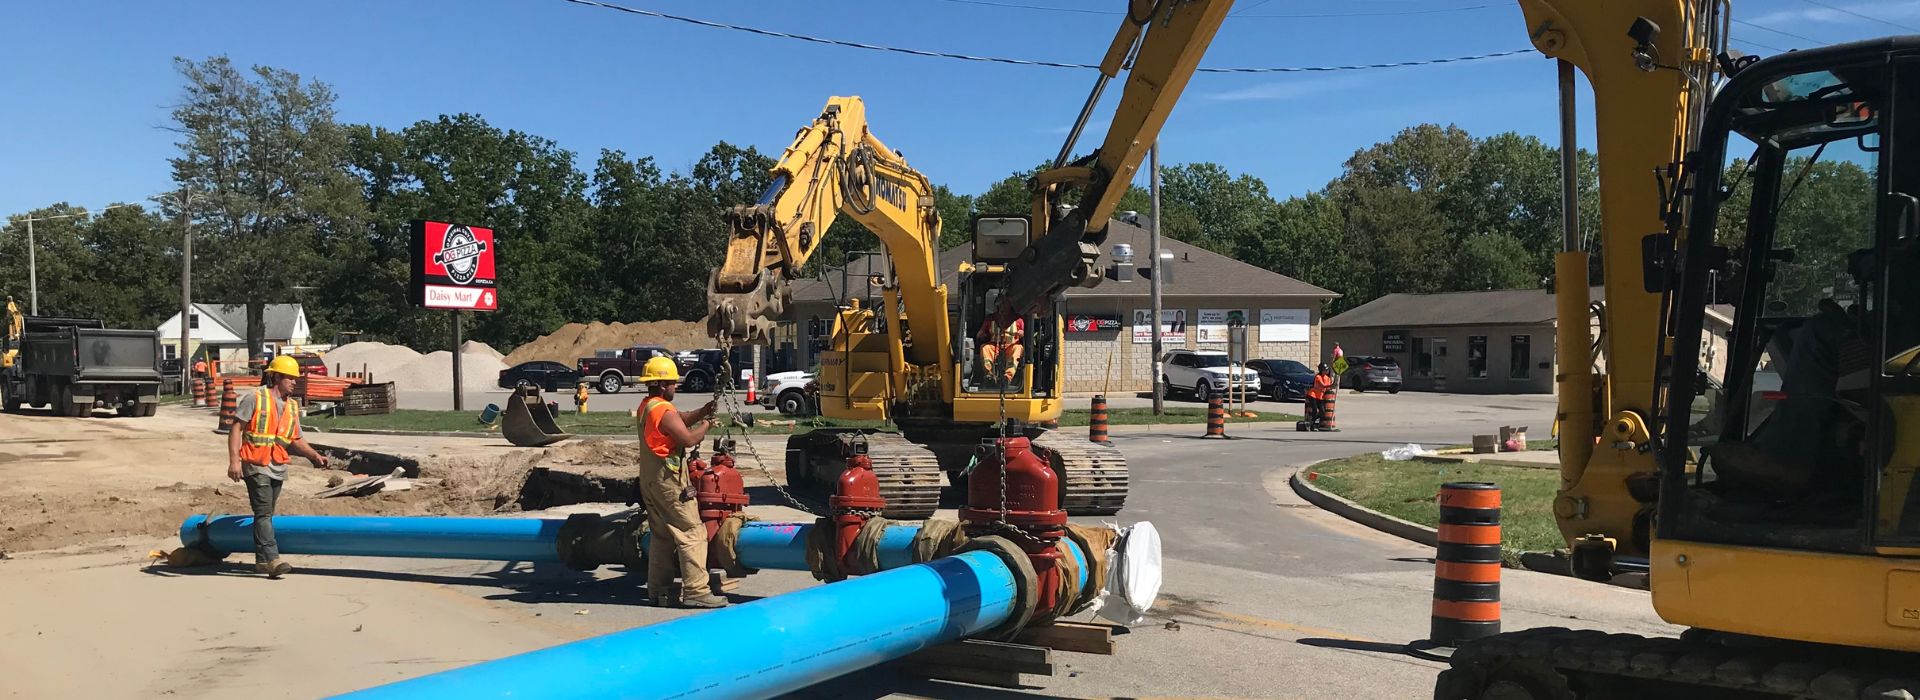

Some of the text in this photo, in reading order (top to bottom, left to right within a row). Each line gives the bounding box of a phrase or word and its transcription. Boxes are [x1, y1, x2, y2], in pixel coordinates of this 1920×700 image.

[875, 173, 907, 213] KOMATSU
[444, 243, 477, 262] OG PIZZA
[451, 269, 466, 280] PIZZA
[429, 289, 473, 303] Daisy Mart
